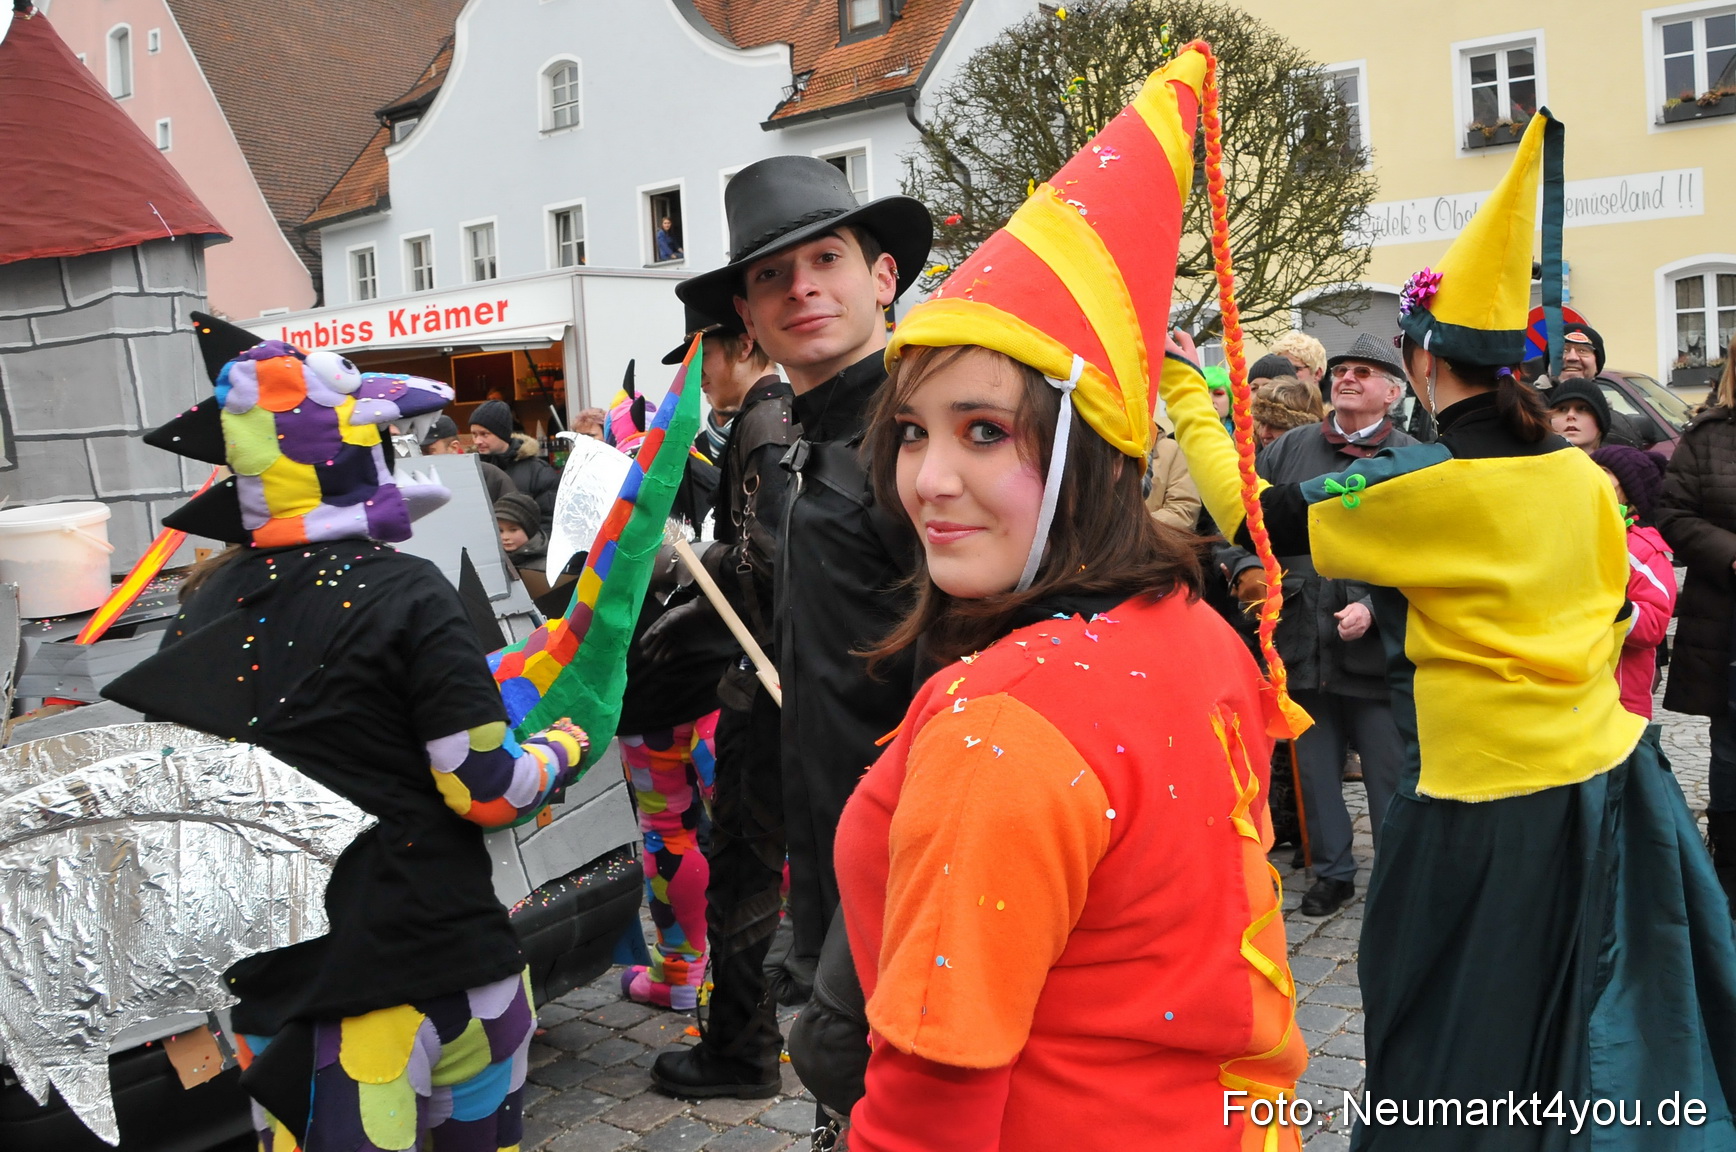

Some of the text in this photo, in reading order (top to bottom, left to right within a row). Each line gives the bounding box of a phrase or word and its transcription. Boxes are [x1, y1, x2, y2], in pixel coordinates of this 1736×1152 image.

[1564, 175, 1665, 219] emüseland
[1678, 172, 1694, 209] !!
[281, 298, 509, 349] Imbiss Krämer
